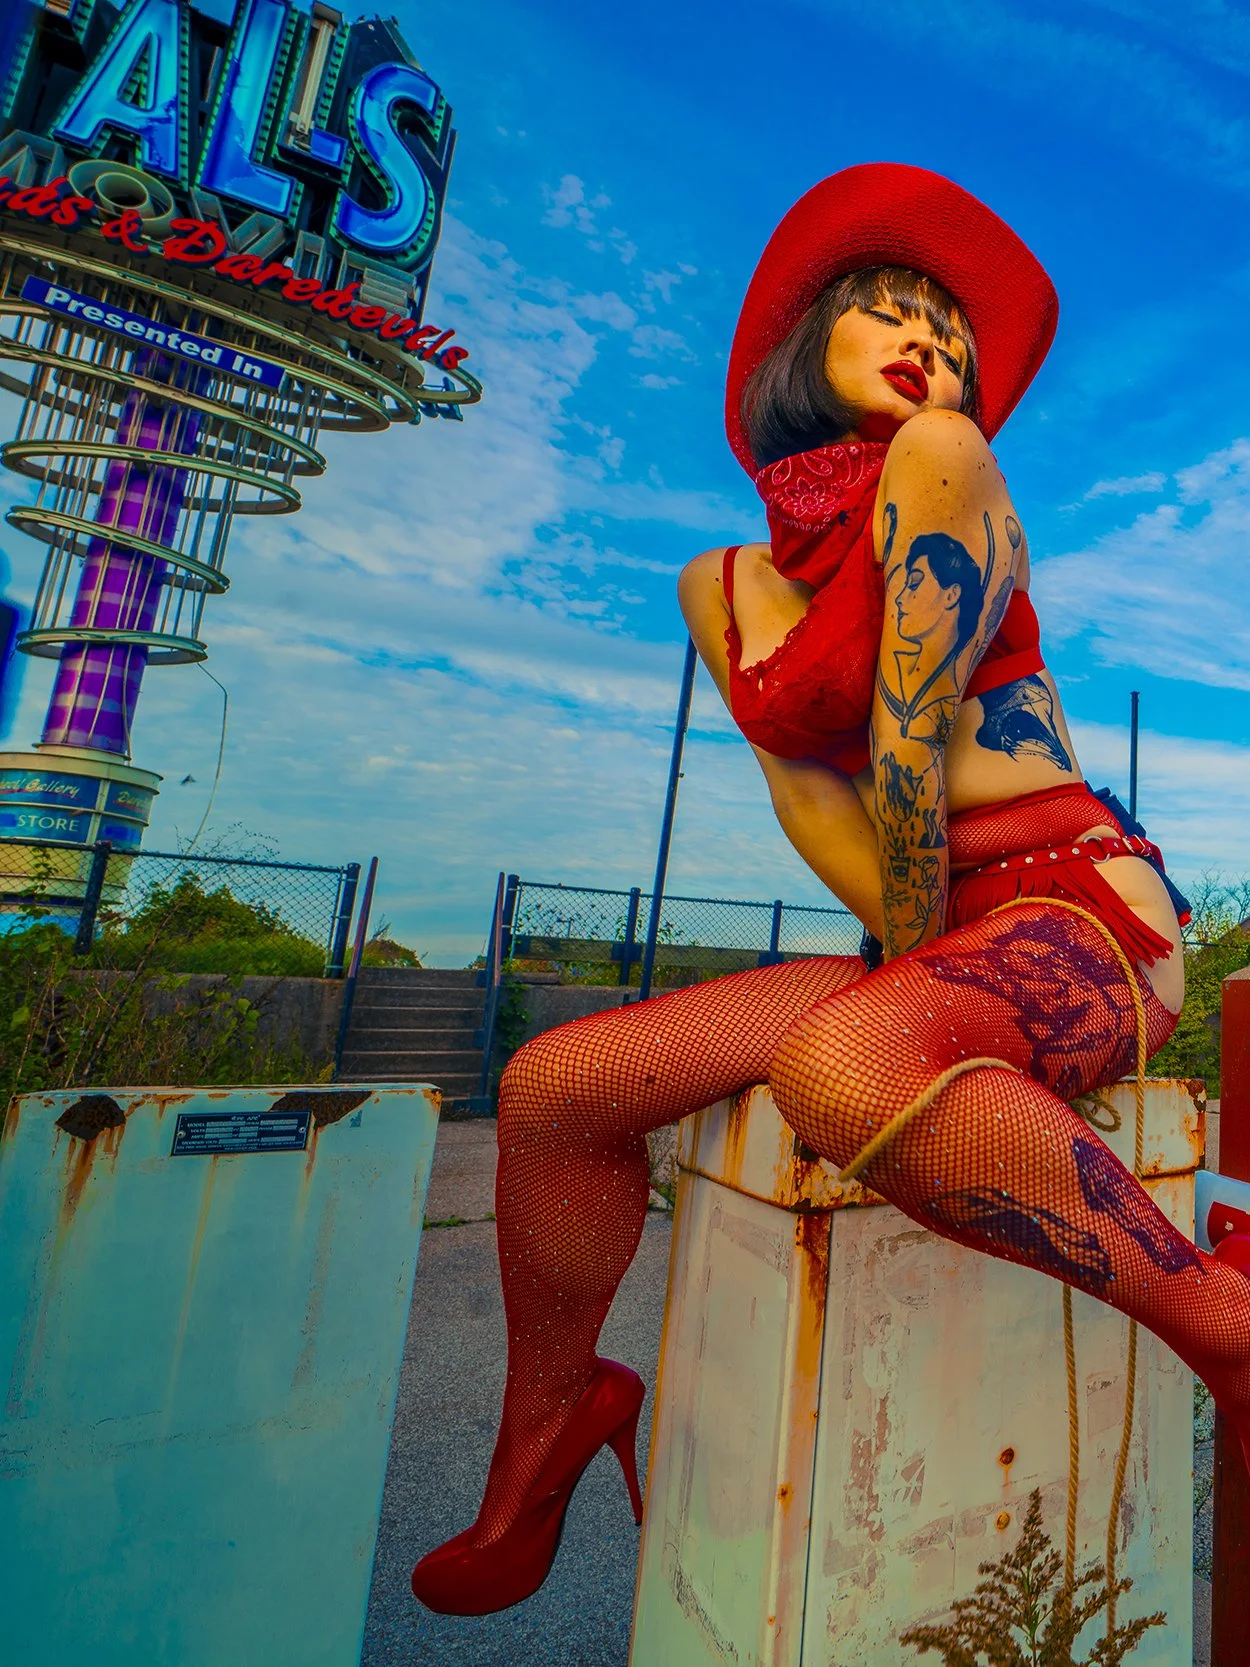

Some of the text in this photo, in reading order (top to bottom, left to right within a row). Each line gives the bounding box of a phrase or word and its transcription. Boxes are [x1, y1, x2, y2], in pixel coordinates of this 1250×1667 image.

[0, 0, 438, 250] ALLS
[44, 287, 263, 379] Presented In
[101, 209, 148, 252] &
[163, 217, 470, 371] Daredevils
[17, 815, 80, 832] STORE
